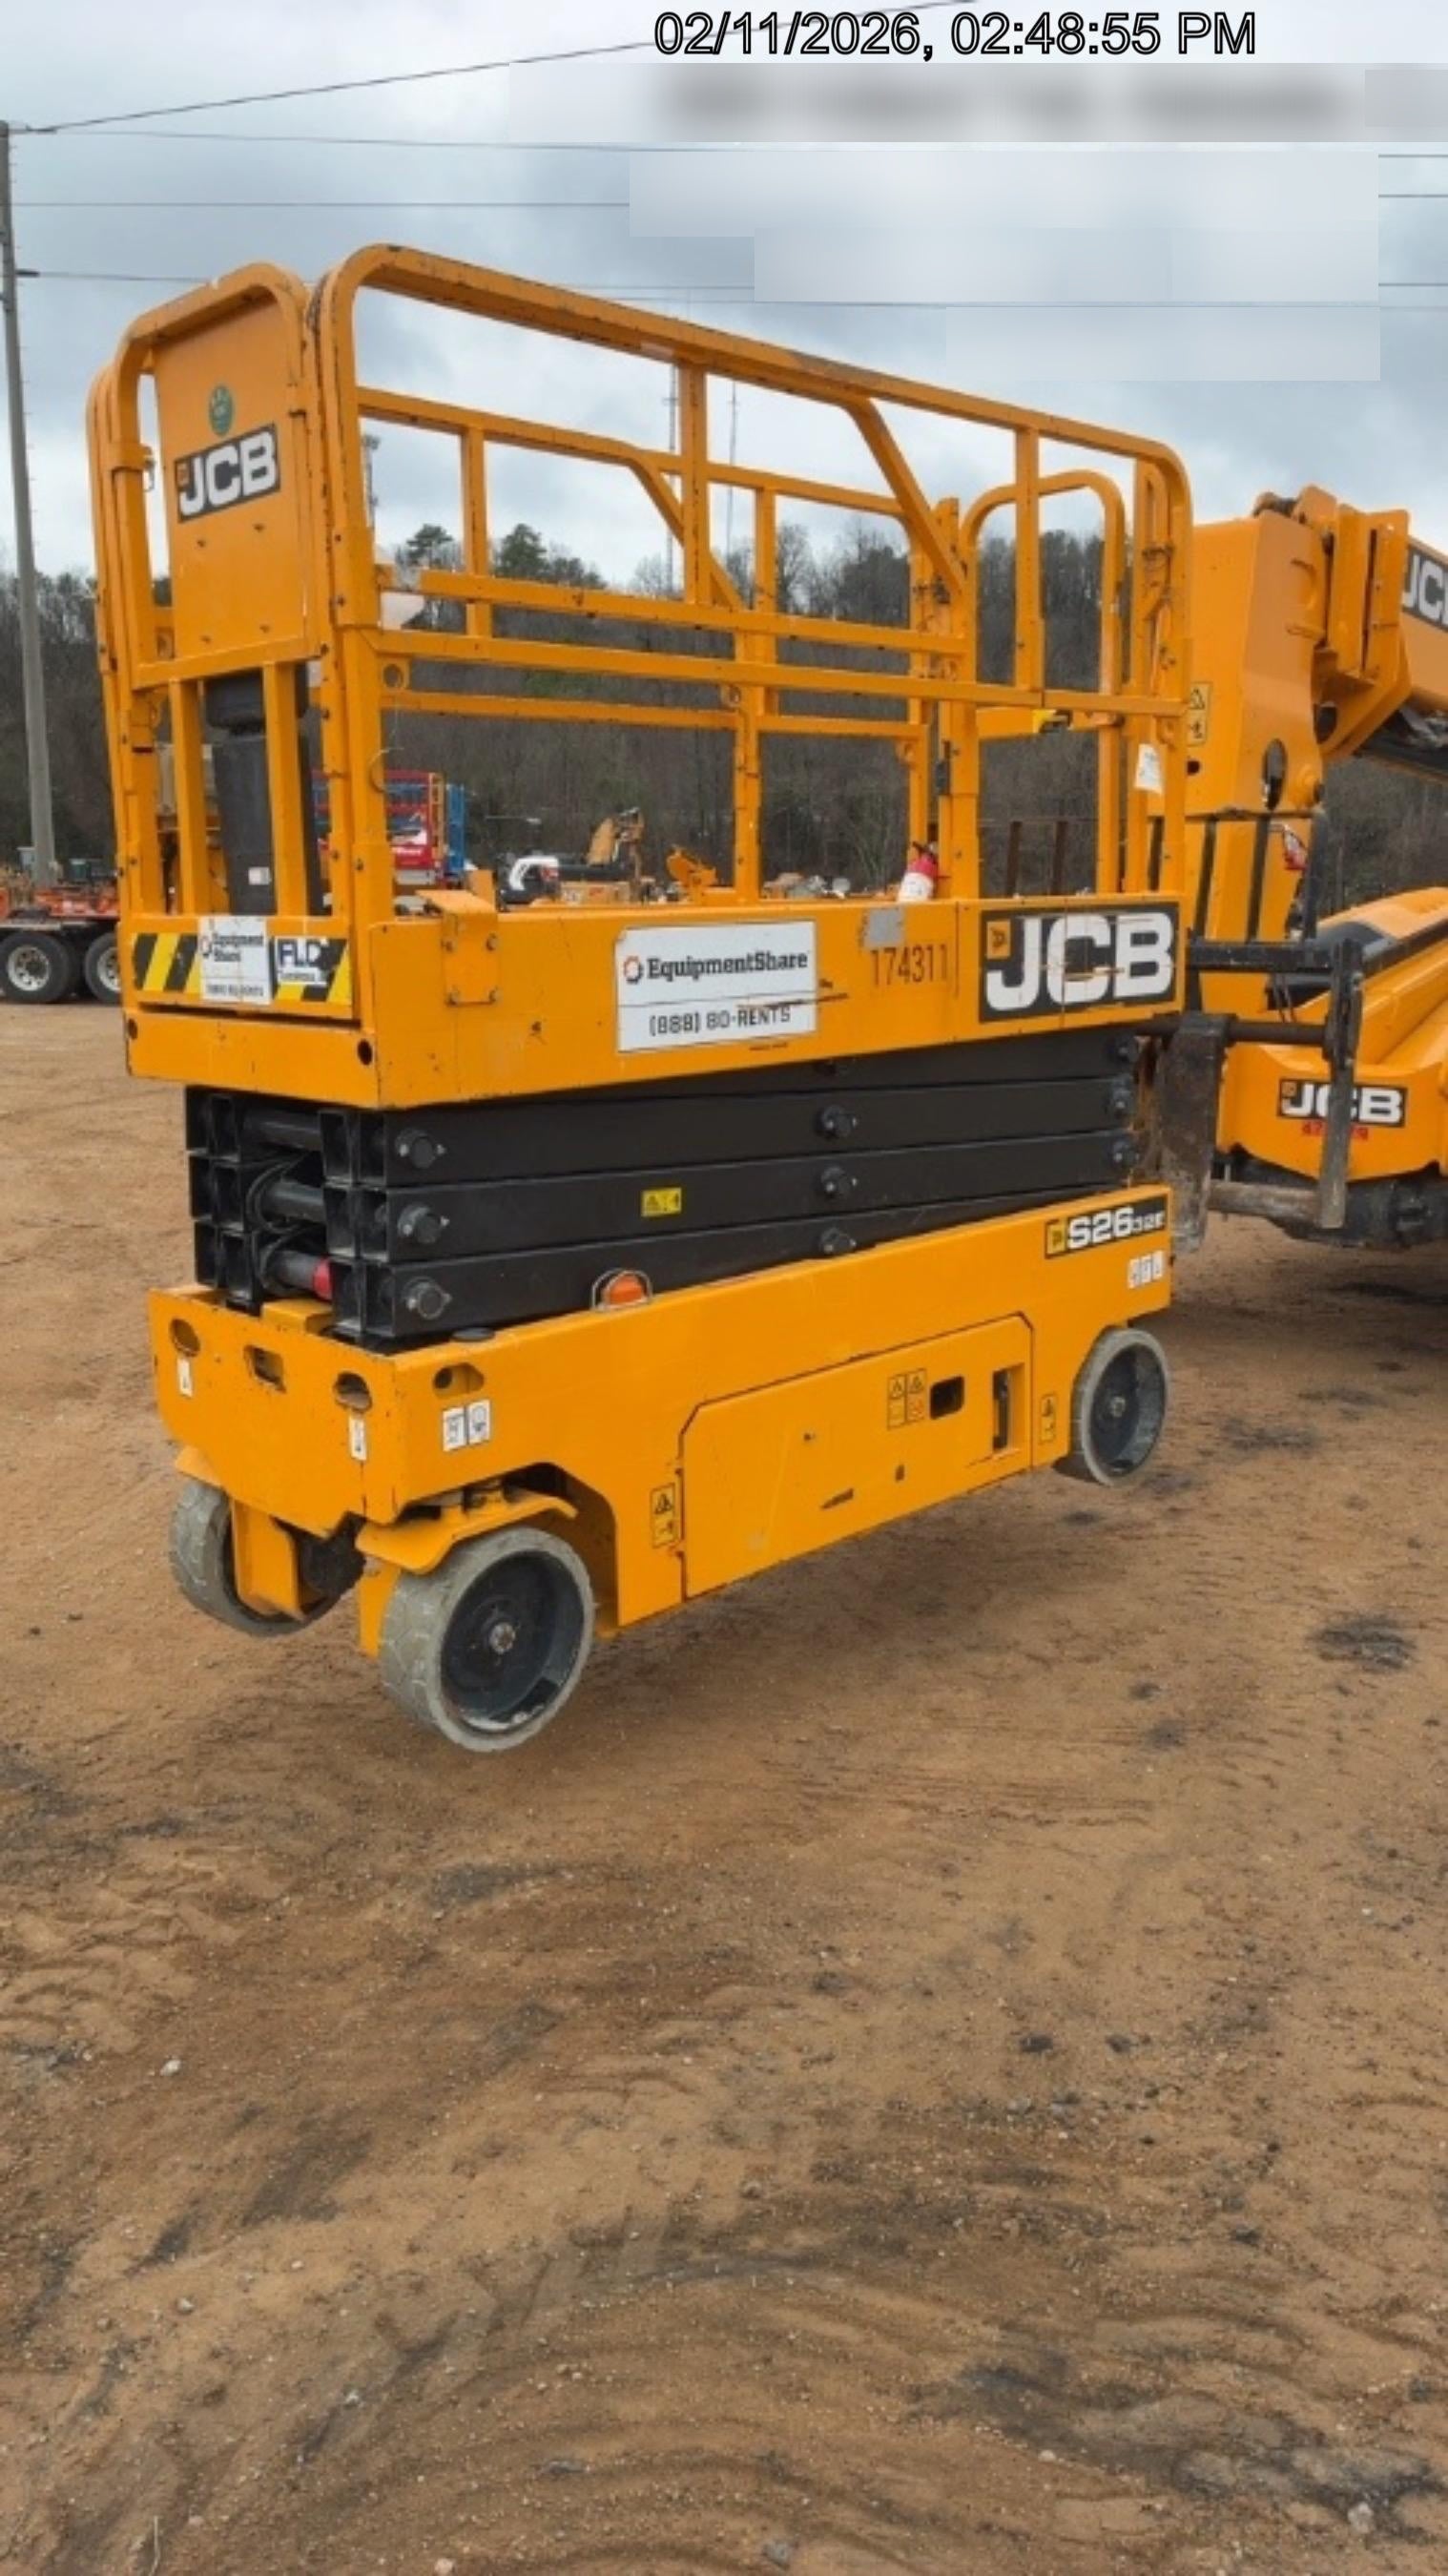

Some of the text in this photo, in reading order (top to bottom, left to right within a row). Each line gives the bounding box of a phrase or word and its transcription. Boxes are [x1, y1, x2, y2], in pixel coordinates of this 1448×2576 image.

[179, 430, 277, 516] JCB
[1402, 553, 1448, 626] JC
[646, 950, 809, 983] EquipmentShare
[870, 943, 947, 987] 174311
[986, 912, 1174, 1011] JCB
[649, 1011, 701, 1036] (888)
